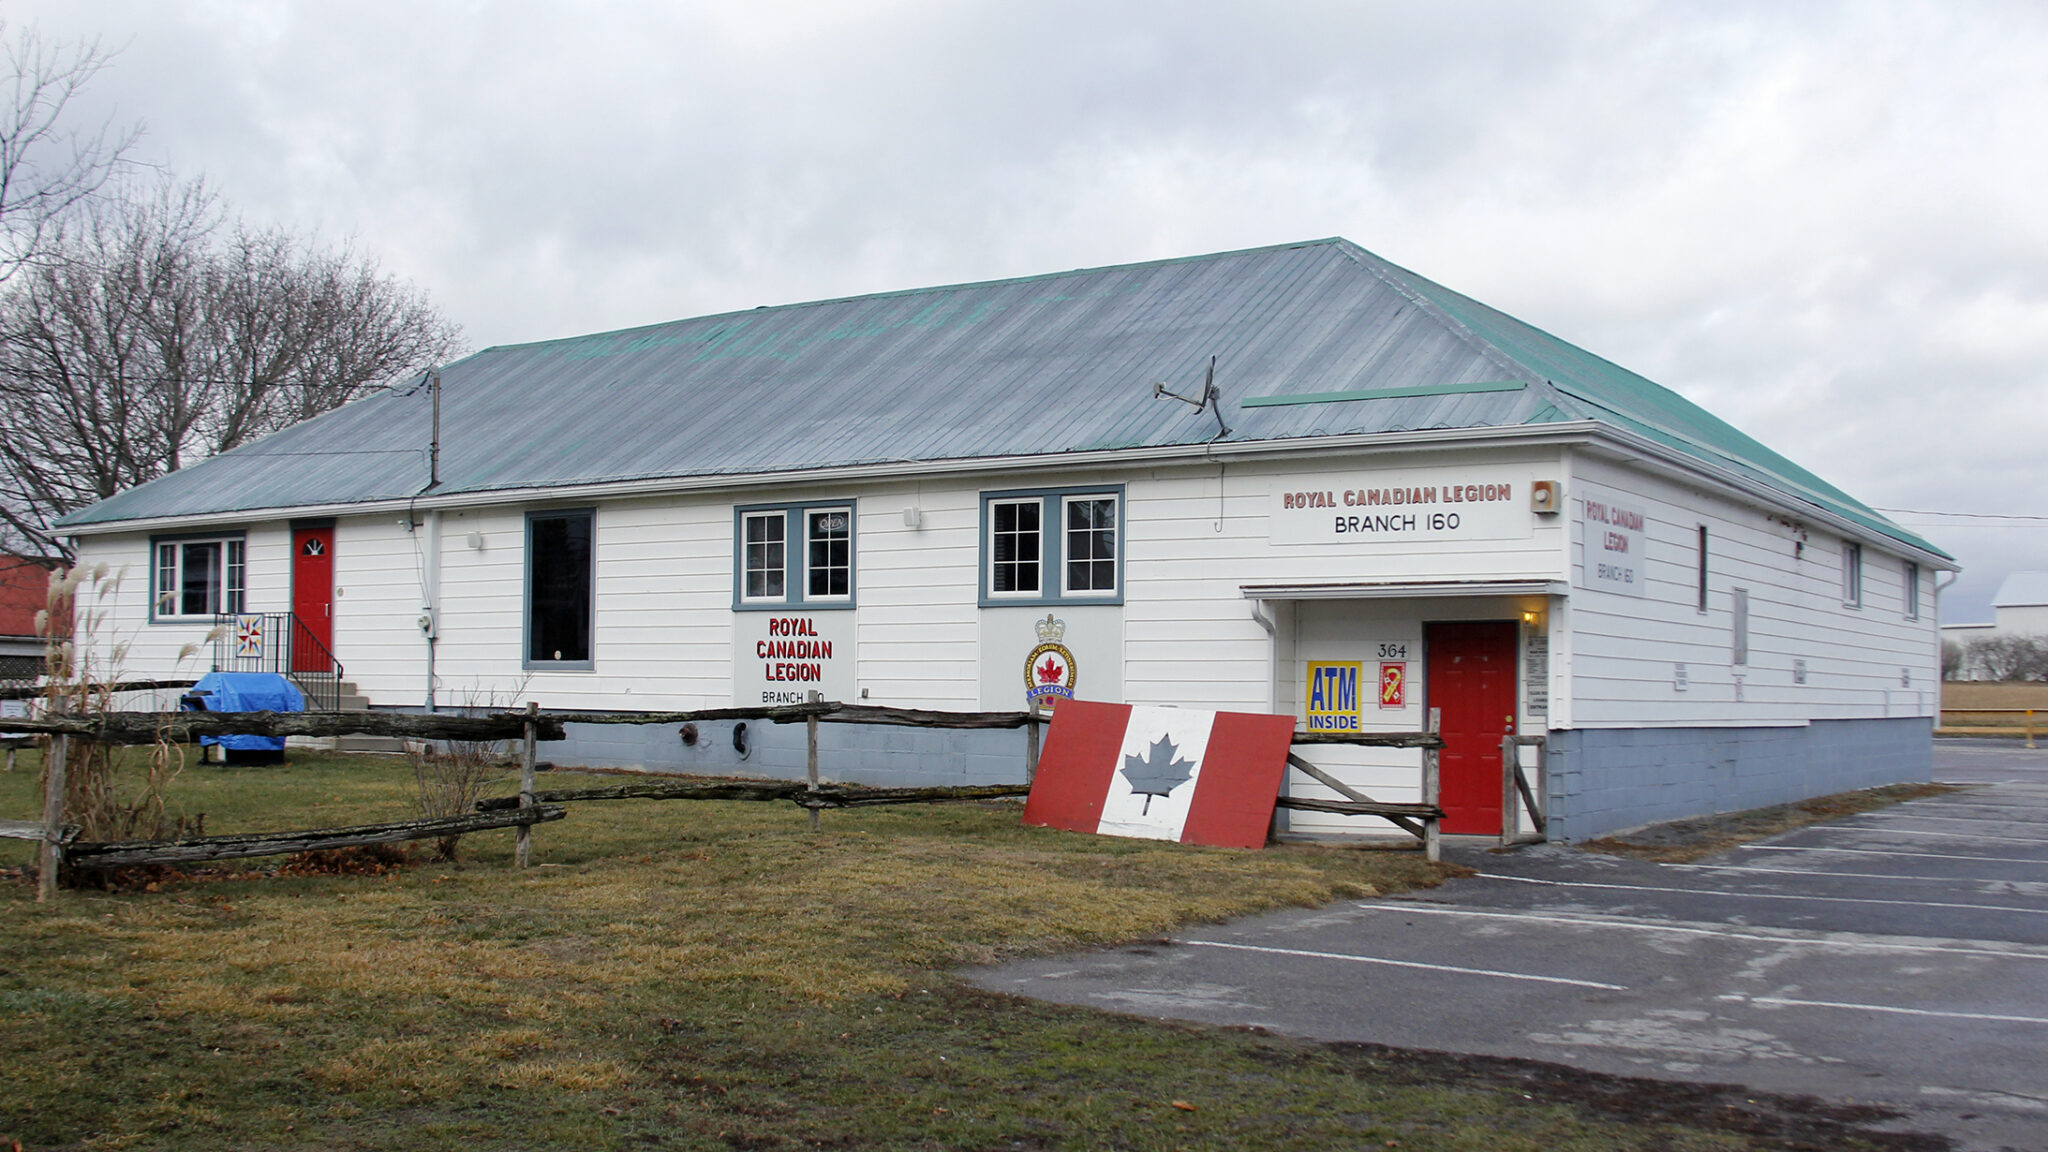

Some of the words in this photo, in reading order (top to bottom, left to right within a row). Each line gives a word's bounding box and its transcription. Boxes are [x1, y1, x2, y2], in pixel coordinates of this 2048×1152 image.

[1283, 490, 1337, 509] ROYAL
[1343, 486, 1437, 506] CANADIAN
[1443, 483, 1511, 503] LEGION
[1335, 513, 1416, 534] BRANCH
[1426, 512, 1461, 531] 160
[1586, 499, 1610, 525] ROYAL
[1611, 506, 1644, 533] CANADIAN
[1604, 530, 1629, 554] LEGION
[1598, 563, 1622, 582] BRANCH
[769, 617, 818, 637] ROYAL
[757, 640, 832, 659] CANADIAN
[1377, 643, 1407, 659] 364
[765, 662, 821, 681] LEGION
[762, 691, 804, 704] BRANCH
[1031, 685, 1070, 697] LEGION
[1310, 666, 1357, 711] ATM
[1309, 715, 1358, 729] INSIDE
